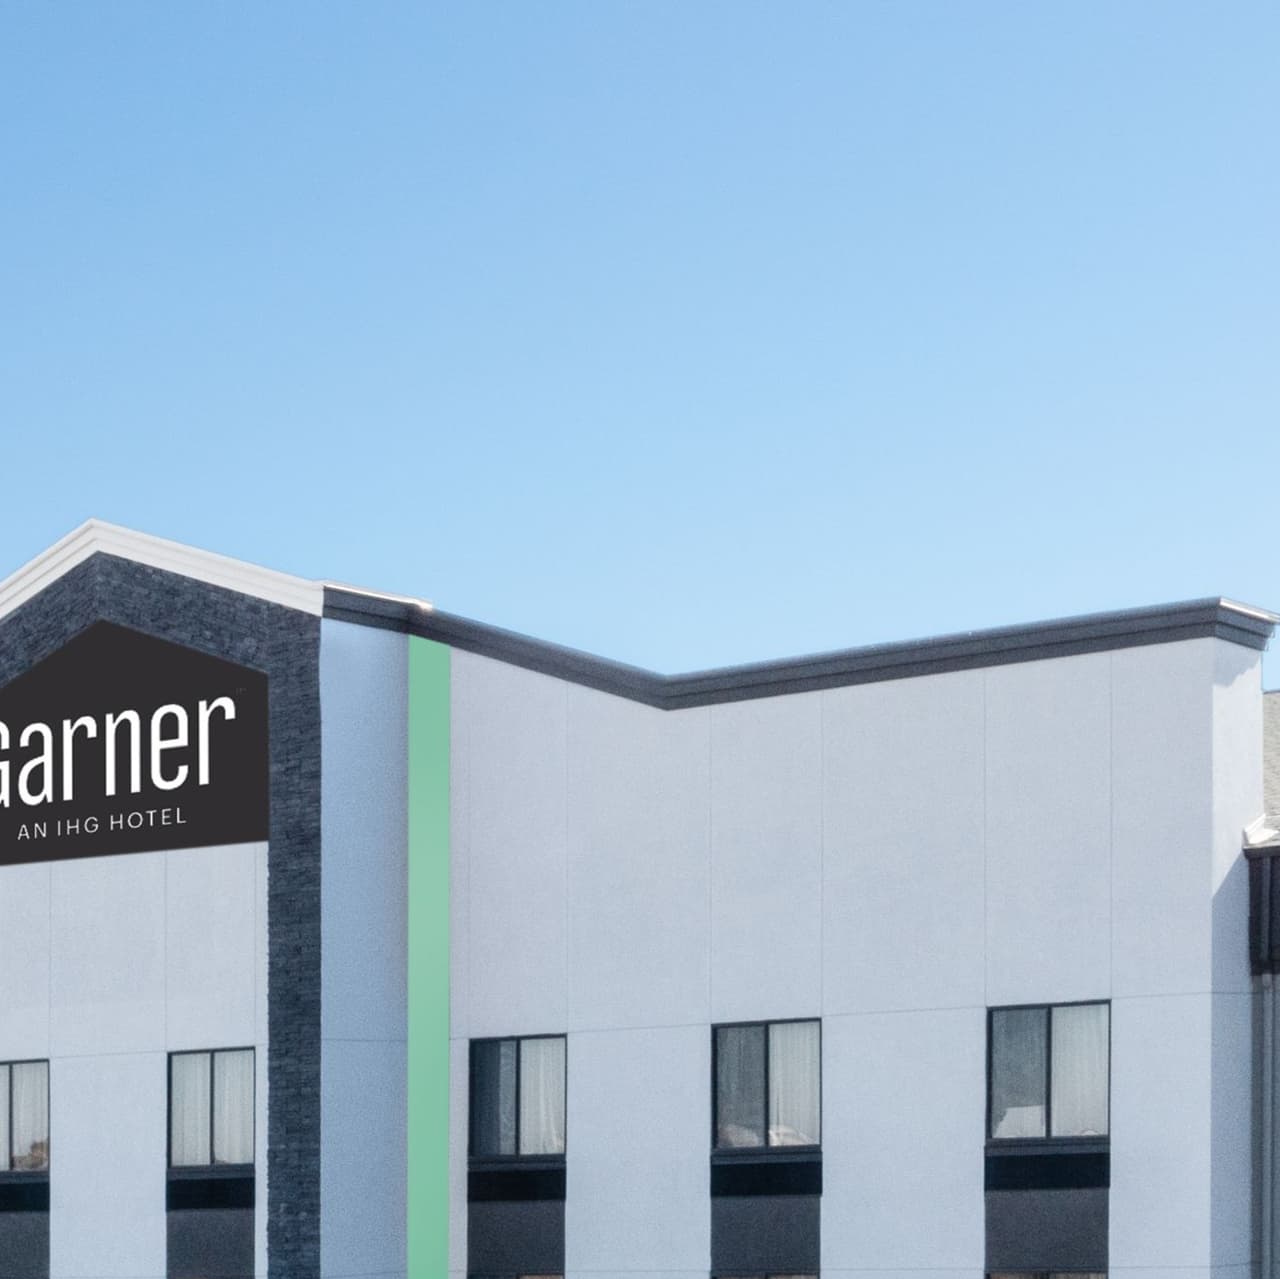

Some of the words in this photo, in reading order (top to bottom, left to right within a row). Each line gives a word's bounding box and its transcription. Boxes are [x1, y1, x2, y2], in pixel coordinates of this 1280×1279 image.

[17, 822, 48, 841] AN
[56, 816, 99, 837] IHG
[110, 807, 187, 831] HOTEL
